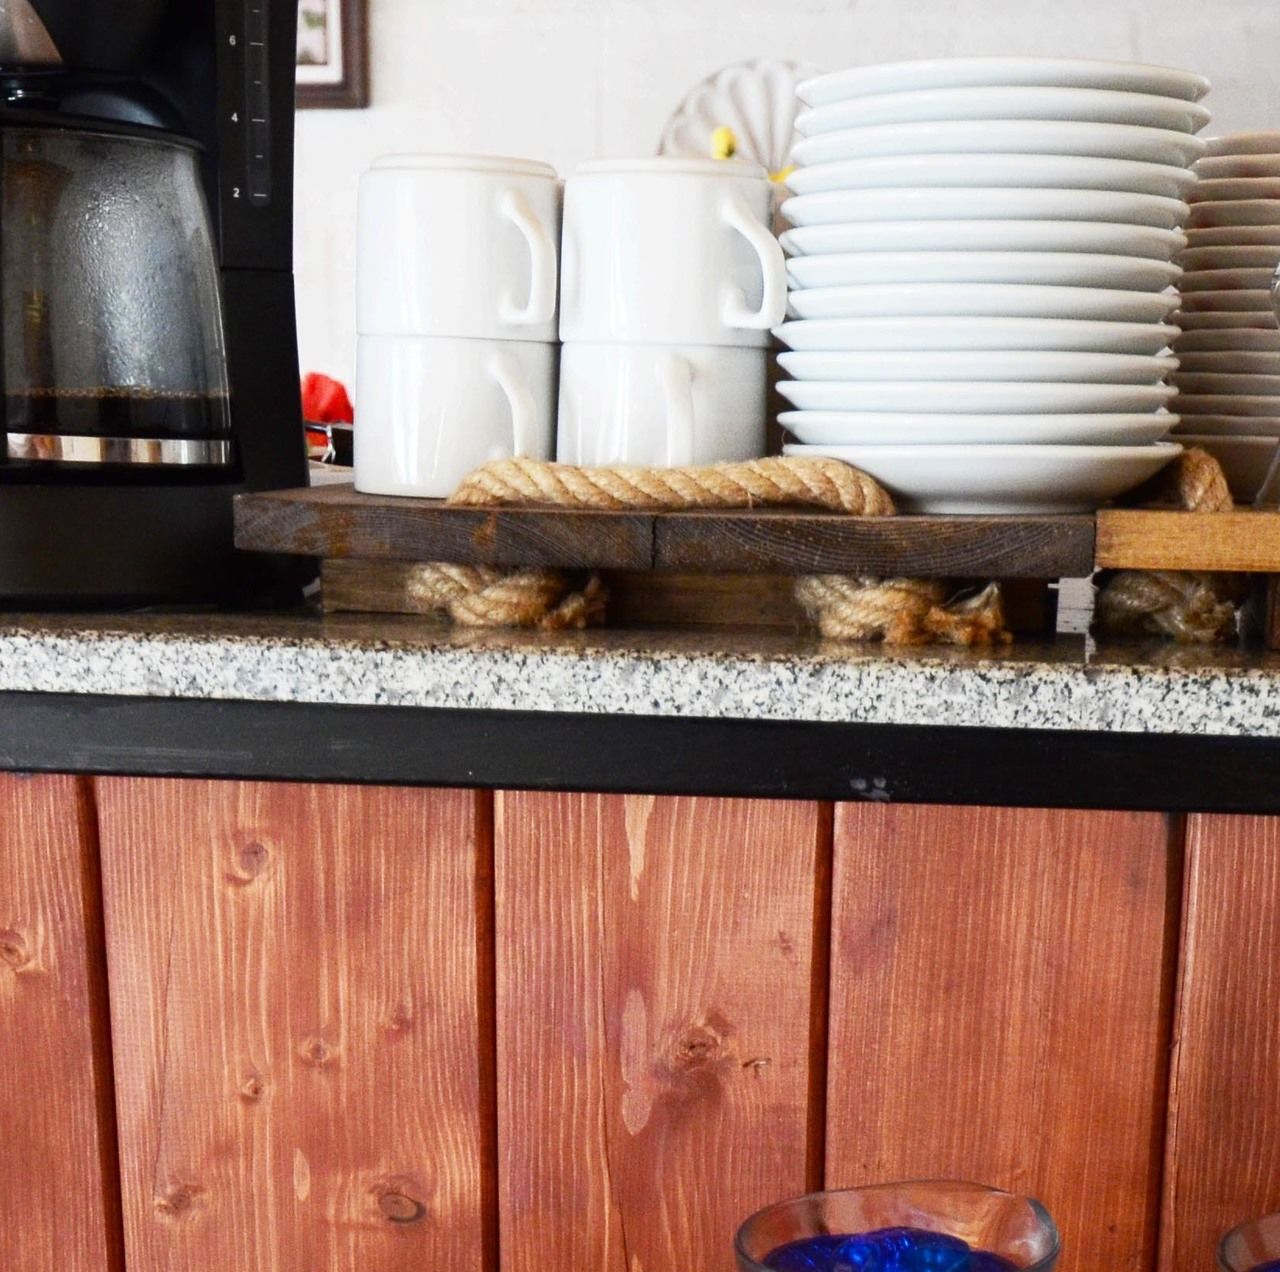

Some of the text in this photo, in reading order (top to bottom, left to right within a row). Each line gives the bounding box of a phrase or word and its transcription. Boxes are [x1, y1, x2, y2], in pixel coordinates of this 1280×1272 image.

[229, 35, 236, 46] 6
[231, 112, 238, 123] 4
[233, 187, 240, 198] 2
